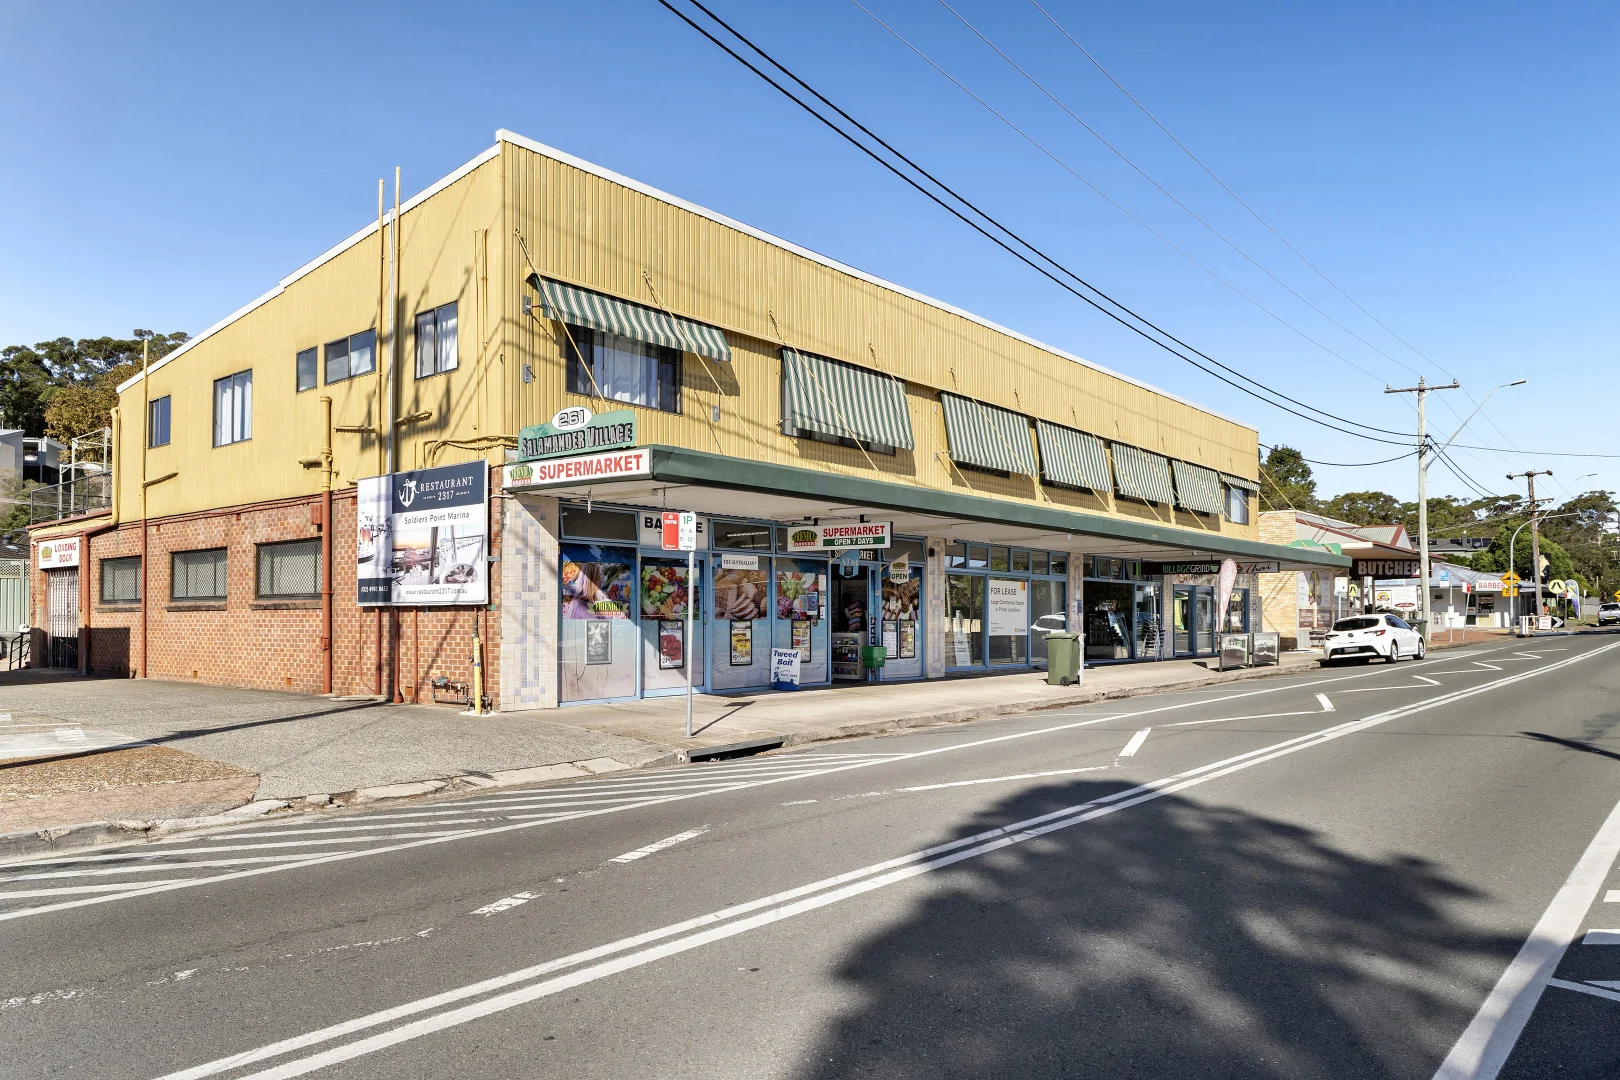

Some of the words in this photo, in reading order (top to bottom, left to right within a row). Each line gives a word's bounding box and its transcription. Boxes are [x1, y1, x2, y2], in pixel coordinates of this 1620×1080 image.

[559, 410, 584, 427] 261
[521, 429, 586, 458] SALAMANDER
[587, 422, 633, 448] VILLAGE
[539, 453, 643, 481] SUPERMARKET
[420, 476, 474, 492] RESTAURANT
[437, 490, 454, 501] 2317
[404, 516, 428, 525] Soldiers
[429, 513, 446, 522] Point
[447, 511, 470, 520] Marina
[683, 515, 693, 524] 1P
[823, 525, 886, 538] SUPERMARKET
[54, 541, 77, 553] LOADING
[834, 538, 851, 546] OPEN
[857, 537, 874, 545] DAYS
[58, 553, 73, 563] DOCK
[841, 557, 859, 567] ATM
[1358, 560, 1420, 576] BUTCHER
[990, 587, 1001, 595] FOR
[1001, 588, 1017, 596] LEASE
[773, 650, 799, 658] Tweed
[777, 658, 793, 666] Bait
